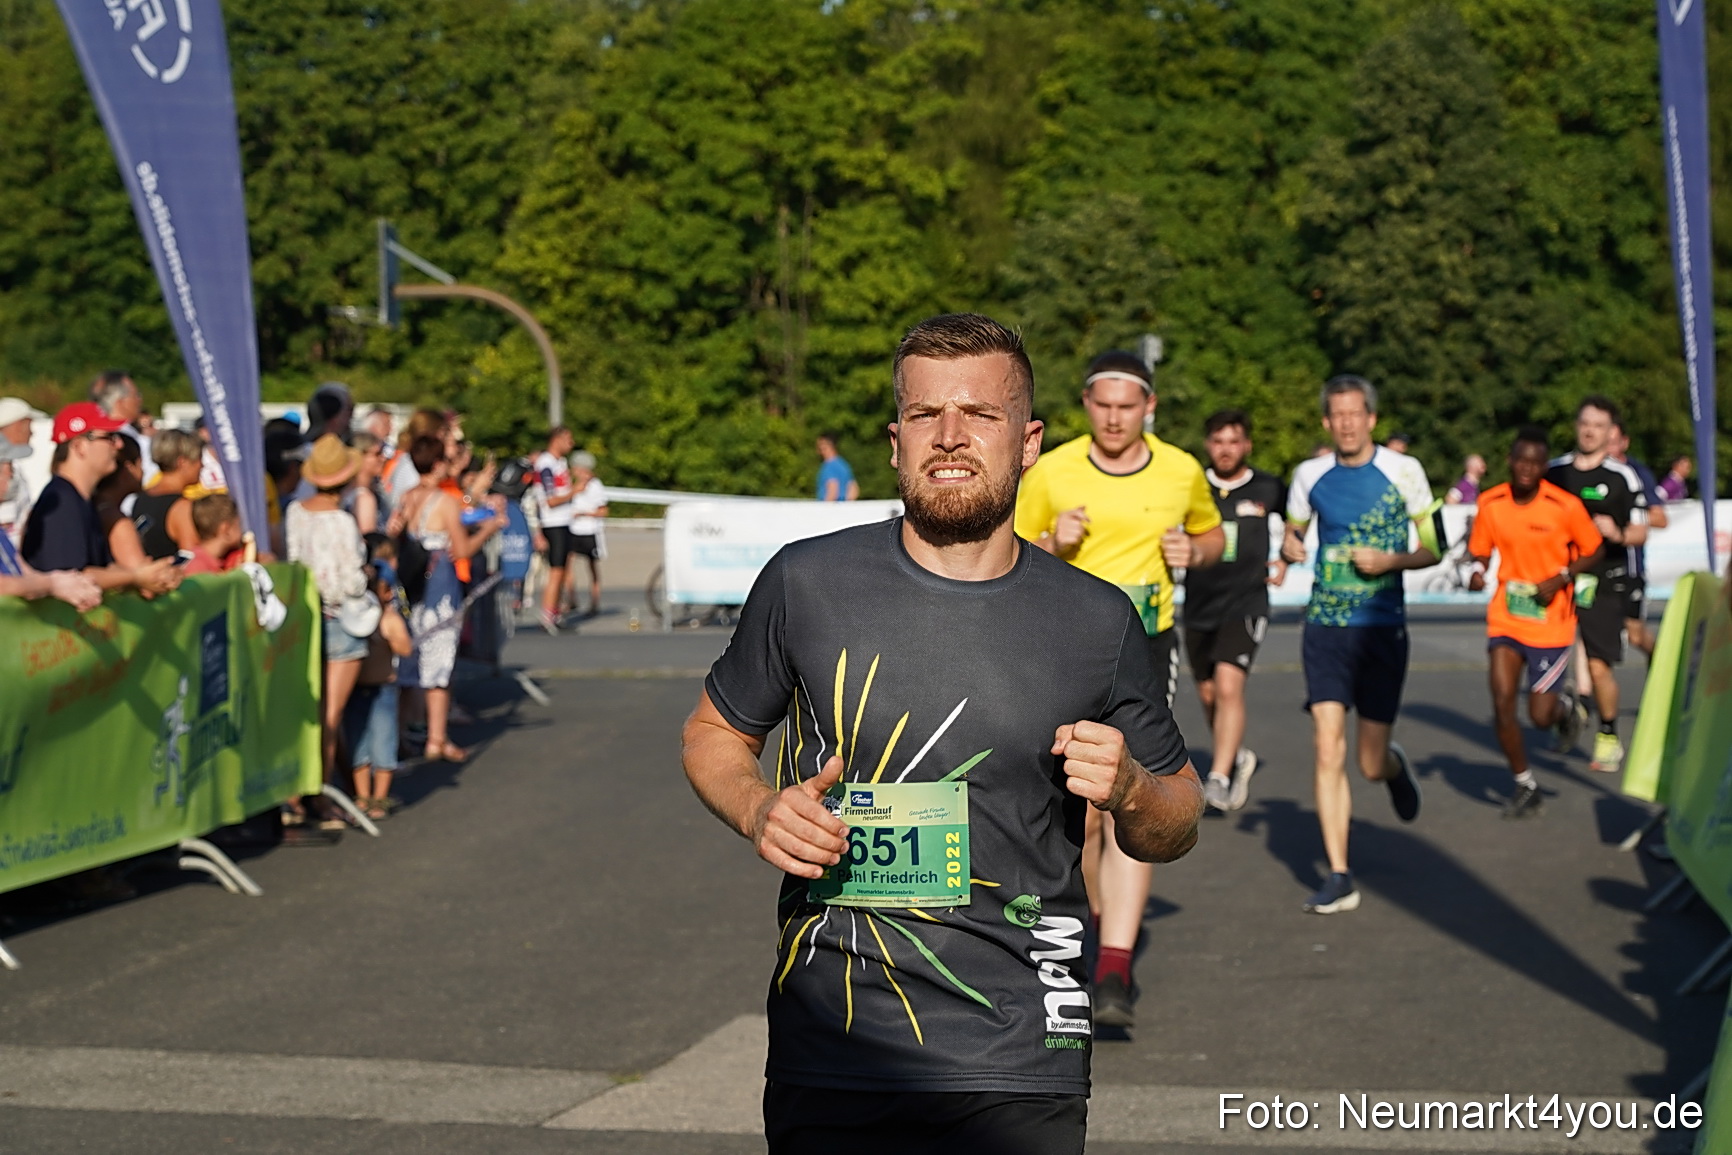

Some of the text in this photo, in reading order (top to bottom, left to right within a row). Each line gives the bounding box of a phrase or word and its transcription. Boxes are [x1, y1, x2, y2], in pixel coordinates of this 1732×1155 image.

[844, 805, 892, 816] Firmenlauf
[845, 826, 920, 867] 651
[945, 832, 961, 889] 2022
[837, 869, 938, 884] Pehl Friedrich
[1030, 915, 1092, 1035] now
